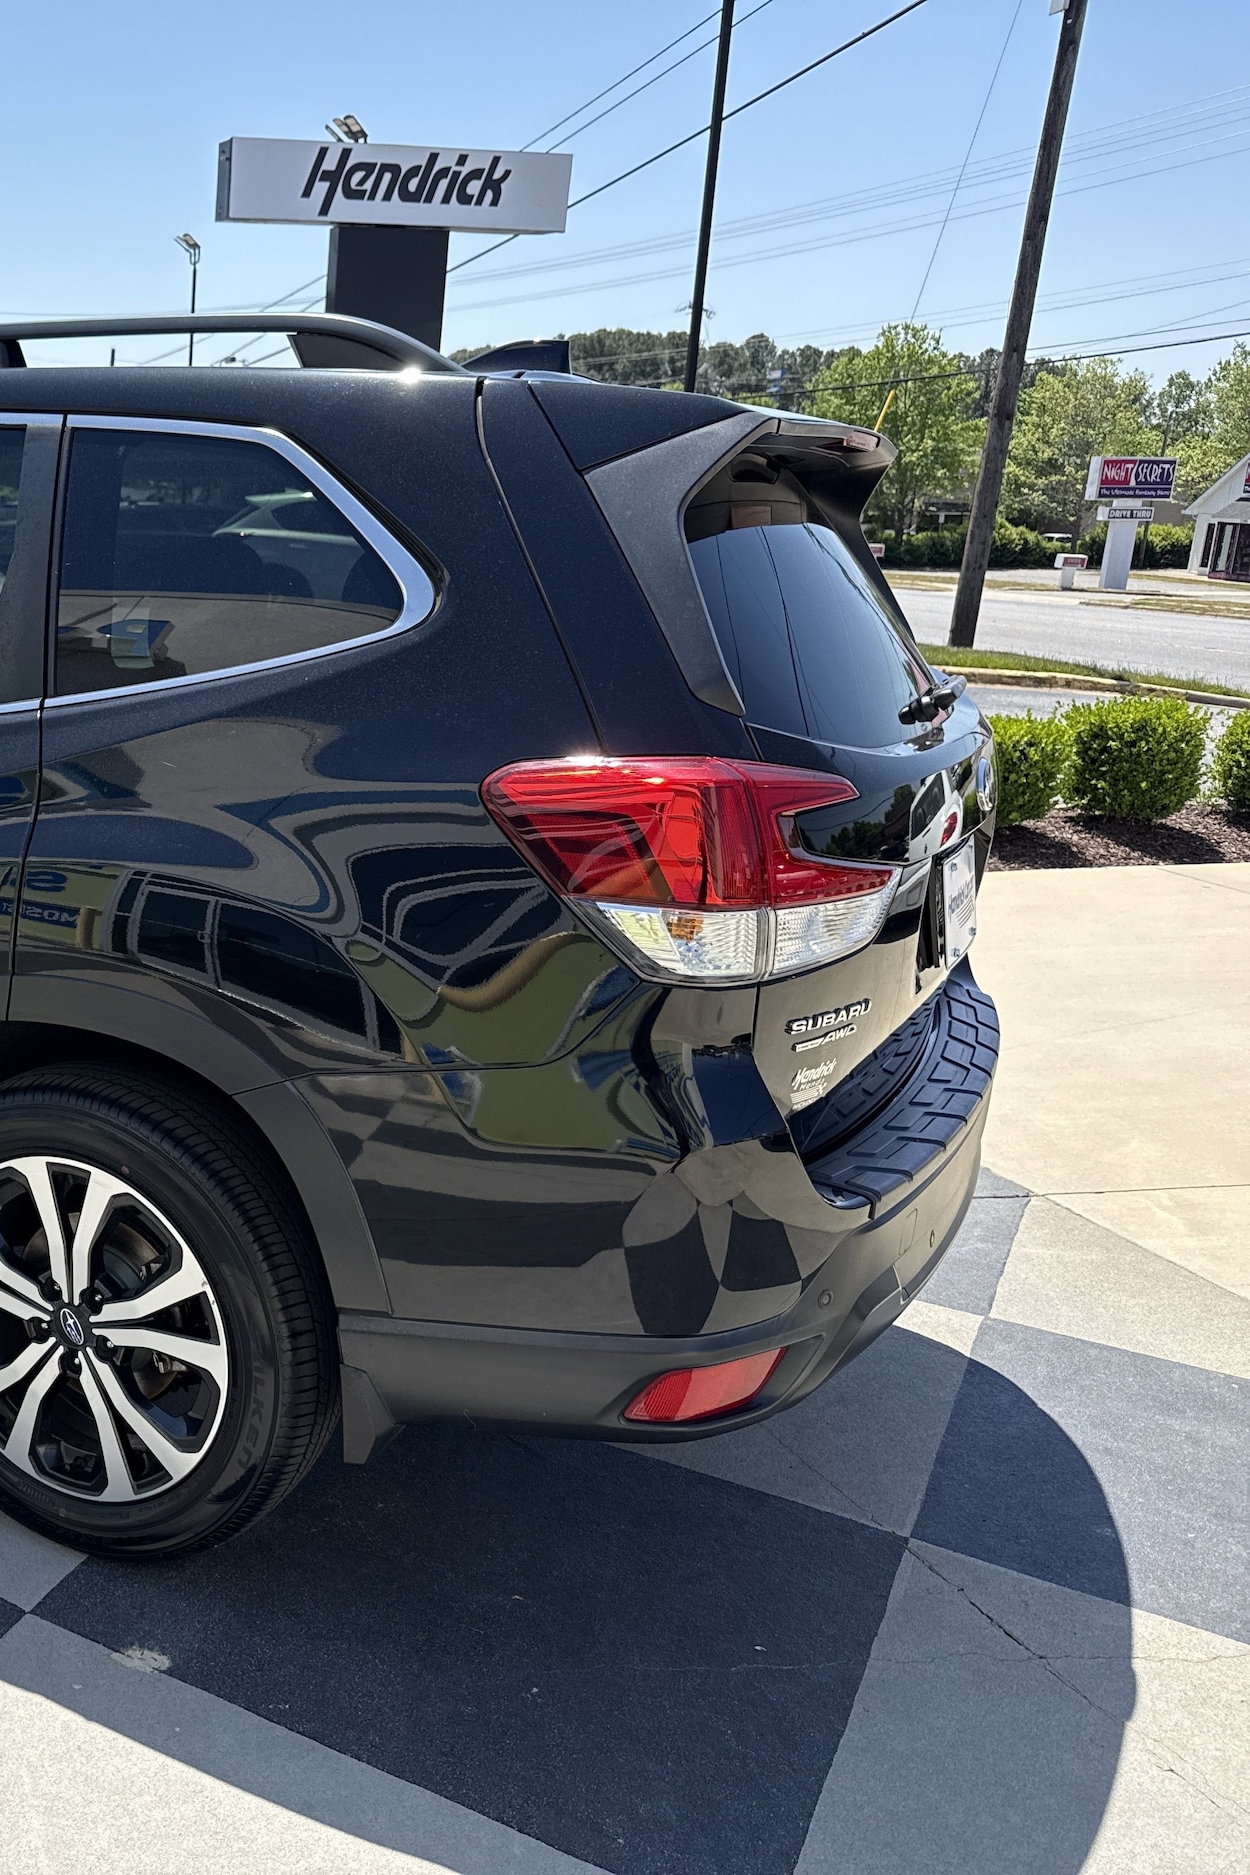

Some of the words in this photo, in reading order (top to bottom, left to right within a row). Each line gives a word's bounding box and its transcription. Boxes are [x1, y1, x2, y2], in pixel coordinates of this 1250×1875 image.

[300, 146, 512, 217] Hendrick
[1137, 463, 1175, 483] SECRETS
[1109, 509, 1131, 518] DRIVE
[1132, 509, 1152, 518] THRU
[786, 999, 872, 1035] SUBARU
[821, 1024, 857, 1045] AWD
[791, 1057, 837, 1090] Hendrick
